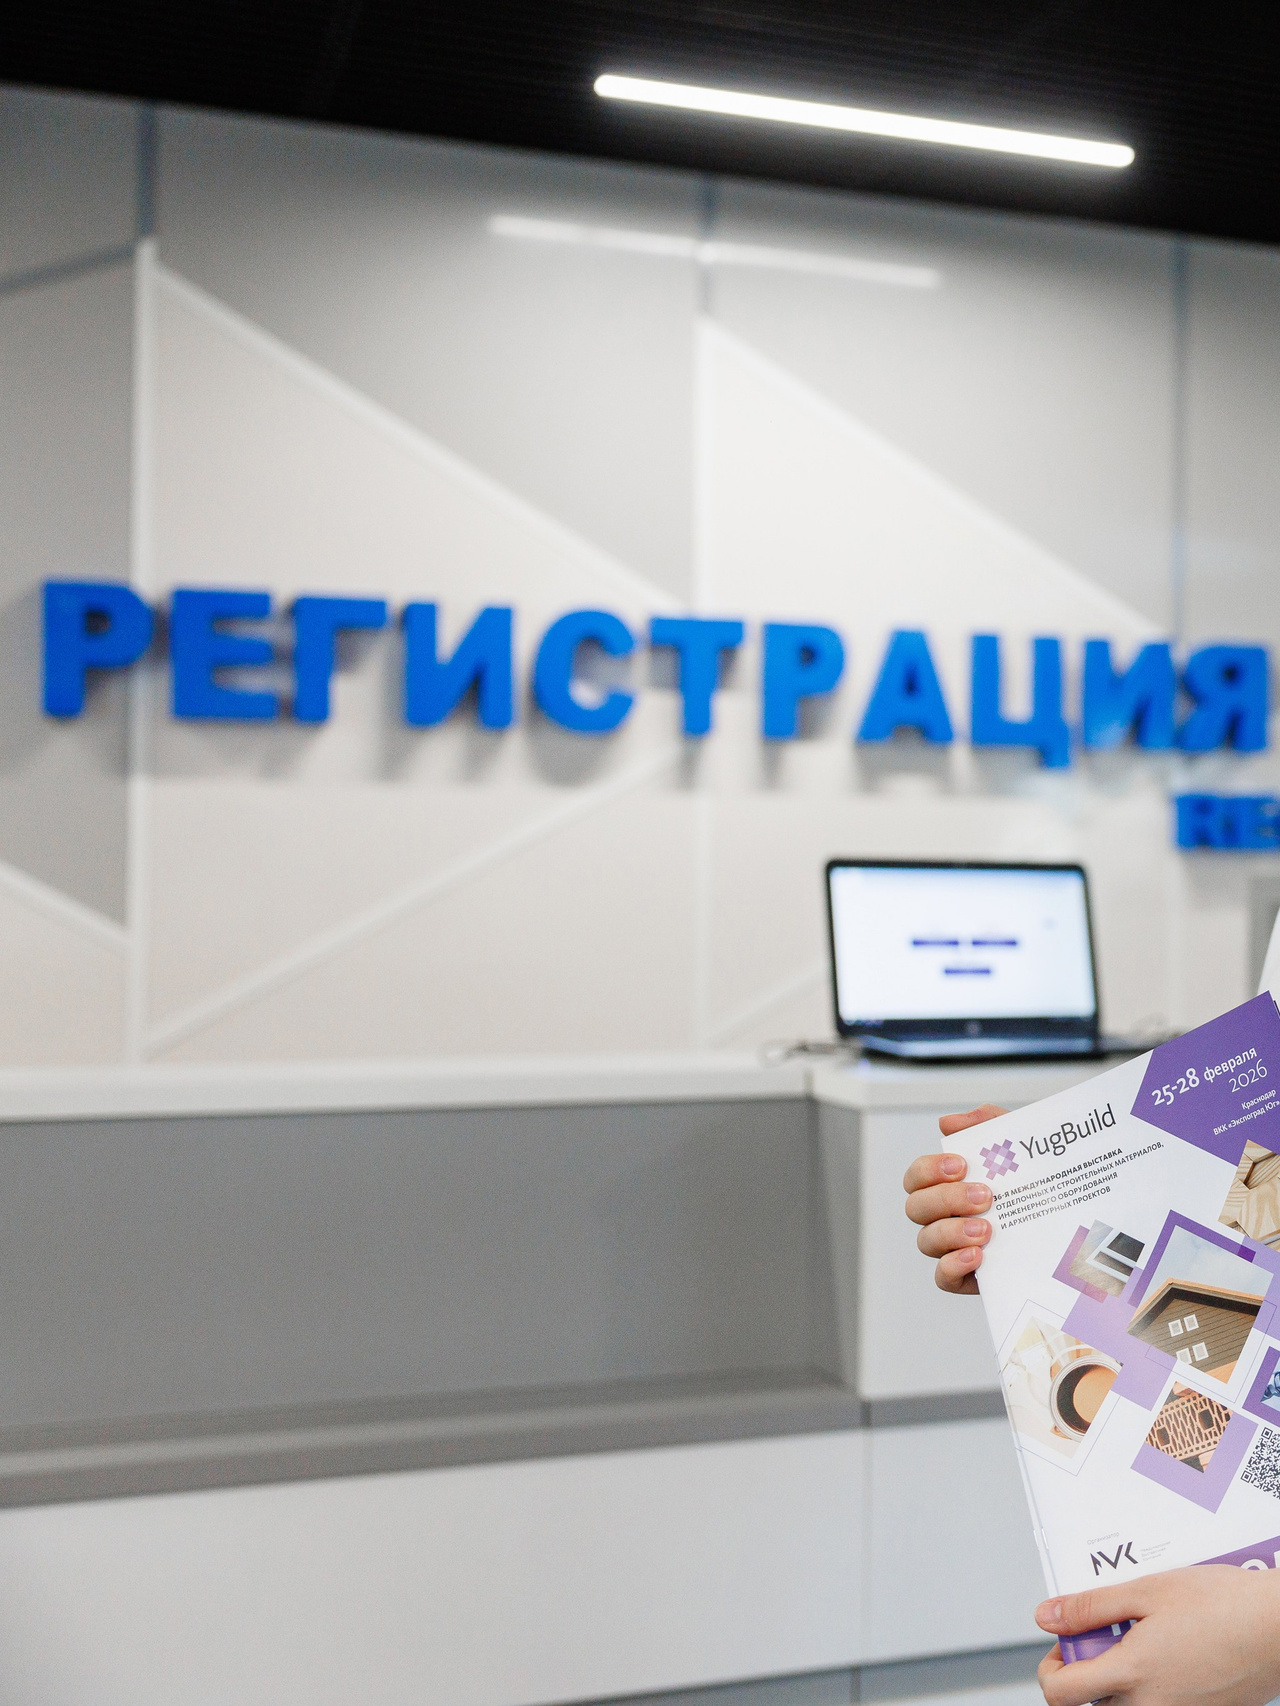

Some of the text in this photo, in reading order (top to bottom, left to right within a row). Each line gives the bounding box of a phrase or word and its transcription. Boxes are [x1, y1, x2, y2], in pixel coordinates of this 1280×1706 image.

[42, 580, 1271, 769] РЕГИСТРАЦИЯ
[1151, 1047, 1258, 1106] 25-28 февраля
[1228, 1058, 1268, 1093] 2026
[1241, 1089, 1276, 1110] Краснодар
[1019, 1103, 1116, 1159] YugBuild
[1213, 1100, 1280, 1136] ВКК «Экспоград Юг»
[993, 1148, 1123, 1202] 36-Я МЕЖДУНАРОДНАЯ ВЫСТАВКА
[995, 1141, 1164, 1211] ОТДЕЛОЧНЫХ И СТРОИТЕЛЬНЫХ МАТЕРИАЛОВ,
[998, 1171, 1118, 1220] ИНЖЕНЕРНОГО ОБОРУДОВАНИЯ
[1008, 1201, 1072, 1228] АРХИТЕКТУРНЫХ
[1072, 1185, 1111, 1206] ПРОЕКТОВ
